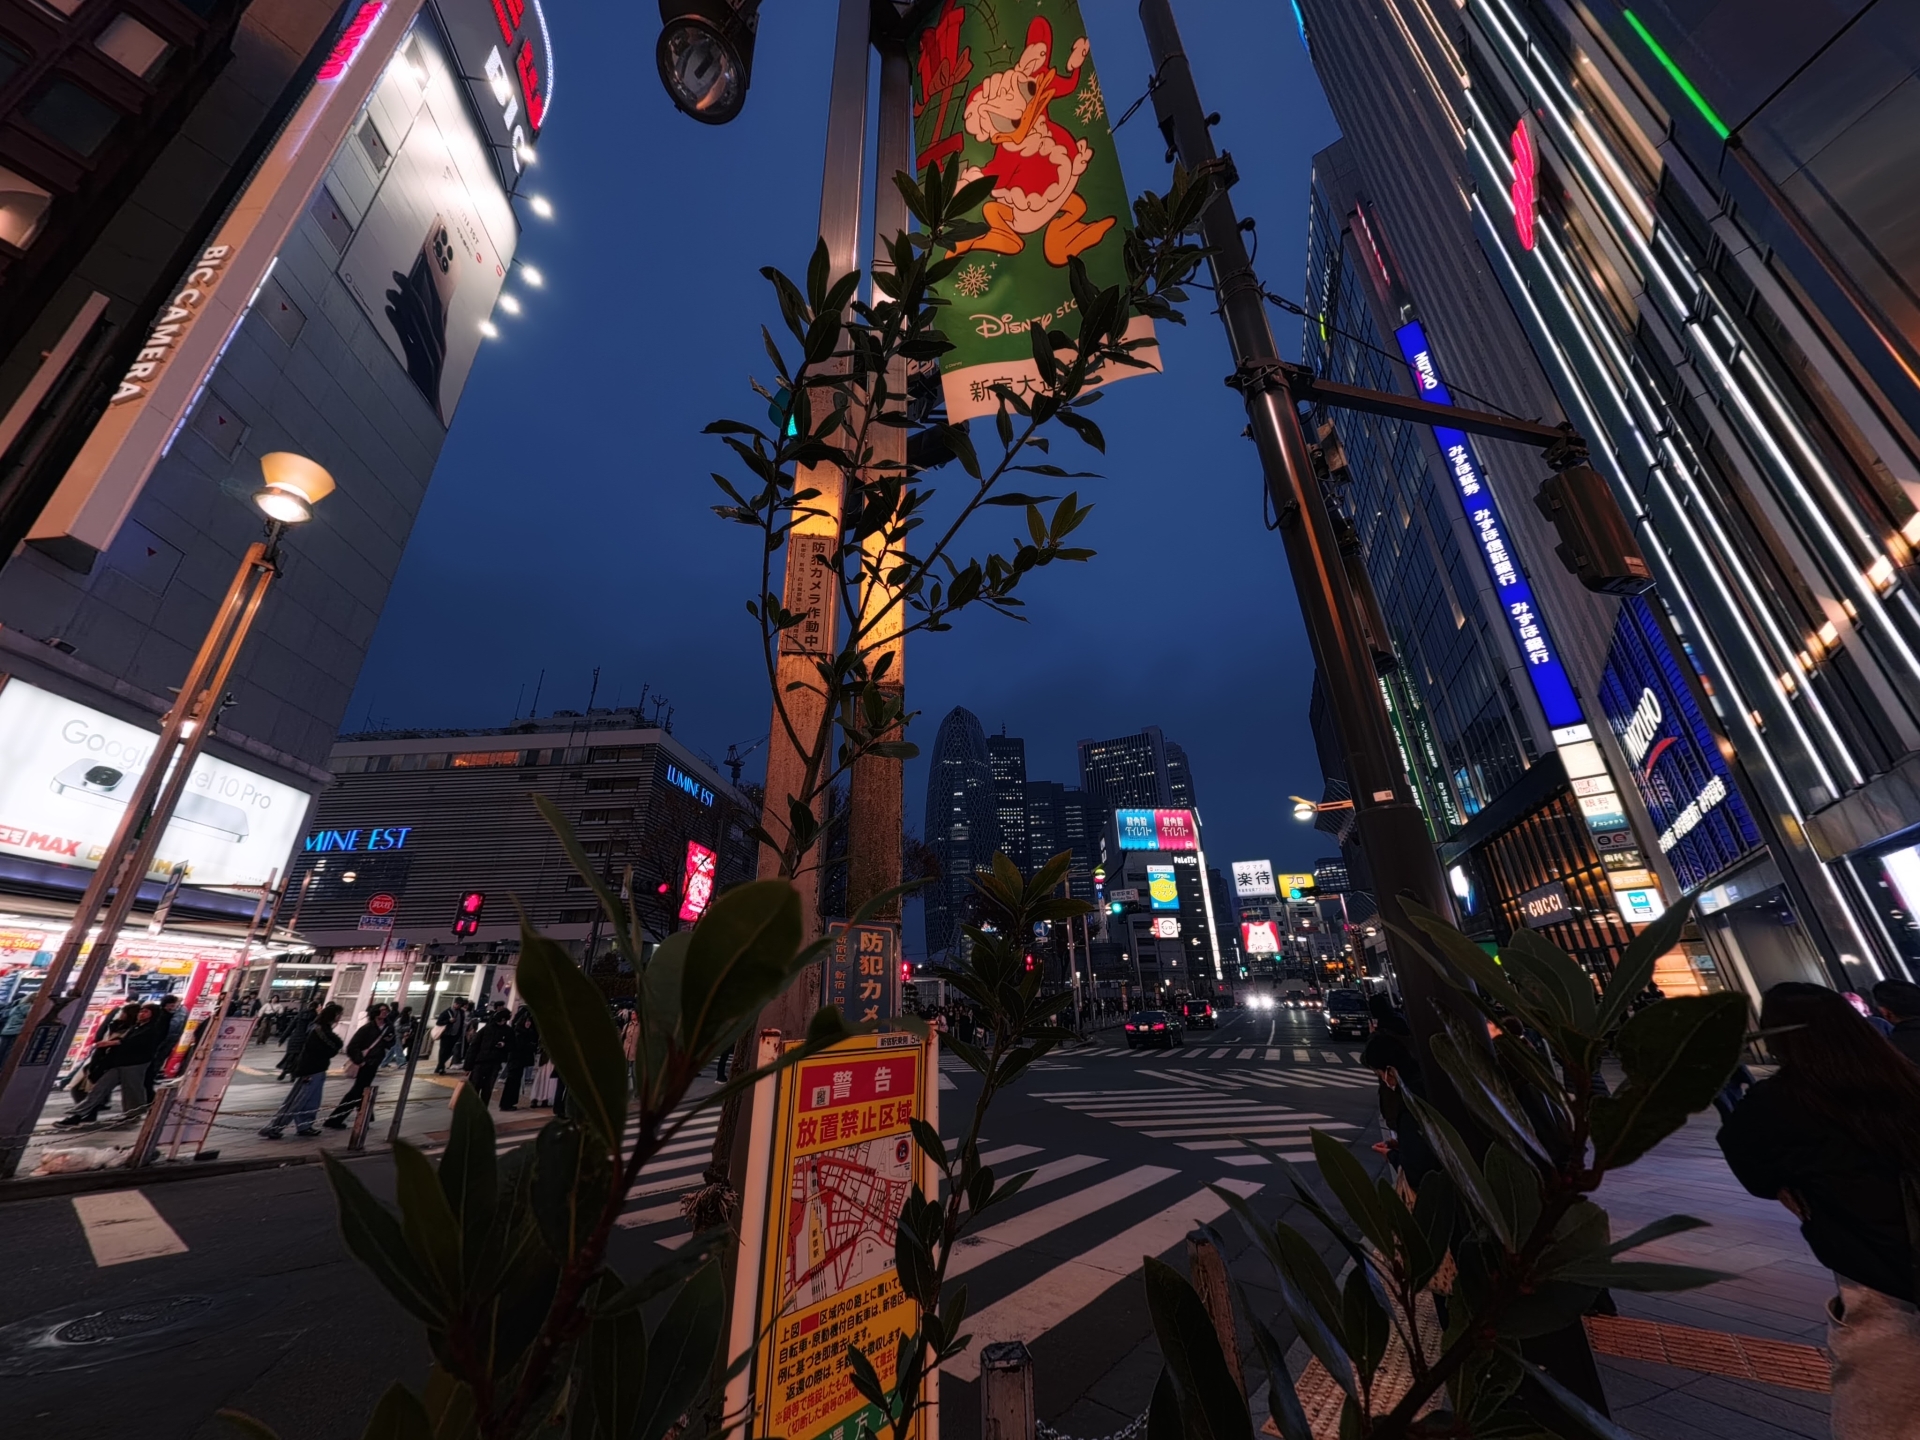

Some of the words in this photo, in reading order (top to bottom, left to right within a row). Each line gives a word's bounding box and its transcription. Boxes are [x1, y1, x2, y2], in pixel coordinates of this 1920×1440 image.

[188, 245, 231, 287] BIC
[110, 288, 203, 404] CAMERA
[1414, 351, 1437, 389] MIZUHO
[1448, 444, 1480, 496] みずほ証券
[1473, 508, 1517, 586] みずほ信託銀行
[804, 542, 826, 647] 防犯カメラ作動中
[1510, 602, 1549, 665] みずほ銀行
[1623, 687, 1662, 768] MIZUHO
[61, 719, 151, 769] Googl
[218, 774, 242, 798] 10
[240, 785, 272, 810] Pro
[666, 764, 699, 799] LUMINE
[700, 787, 715, 808] EST
[25, 832, 82, 857] MAX
[367, 827, 413, 850] EST
[1237, 870, 1271, 886] 楽待
[1529, 894, 1563, 917] GUCCI
[14, 939, 41, 949] Store
[832, 1066, 892, 1100] 警告
[796, 1099, 913, 1149] 放置禁止区域
[780, 1319, 800, 1345] 上図
[785, 1327, 901, 1401] 返還の際は、手数を徴収します
